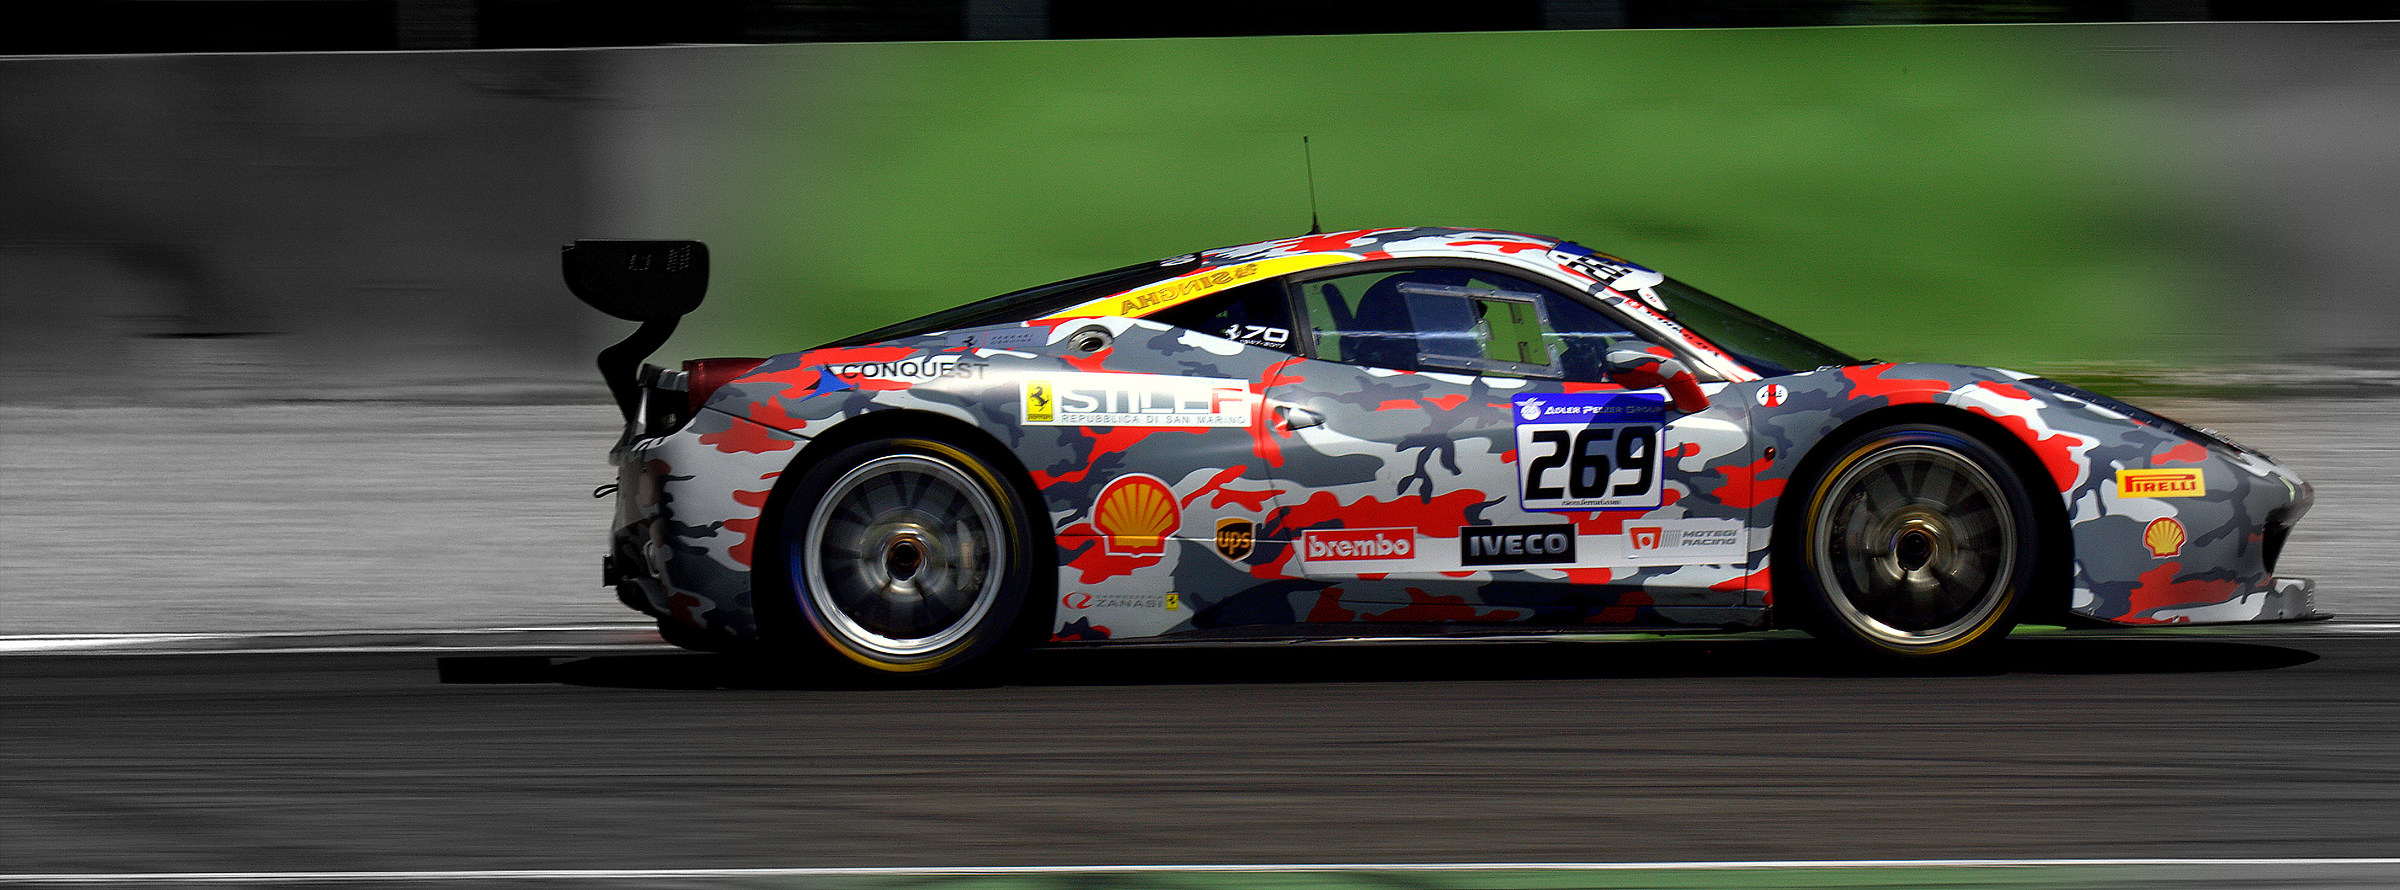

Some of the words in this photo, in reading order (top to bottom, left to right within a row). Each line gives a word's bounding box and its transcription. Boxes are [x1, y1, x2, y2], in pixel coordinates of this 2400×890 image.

[1241, 325, 1290, 343] 70
[842, 361, 990, 380] CONQUEST
[1060, 415, 1141, 424] REPUBBLICA
[1146, 415, 1159, 424] DI
[1166, 415, 1189, 424] SAN
[1197, 415, 1246, 424] MARINO
[1544, 406, 1581, 415] ADLER
[1582, 406, 1623, 415] PELZER
[1525, 426, 1657, 500] 269
[2125, 474, 2196, 493] PIRELLI
[1682, 529, 1737, 537] MOTEGI
[1682, 538, 1737, 546] RACING
[1217, 531, 1251, 555] ups
[1309, 533, 1411, 558] brembo
[1470, 533, 1569, 557] IVECO
[1096, 599, 1163, 608] ZANASI
